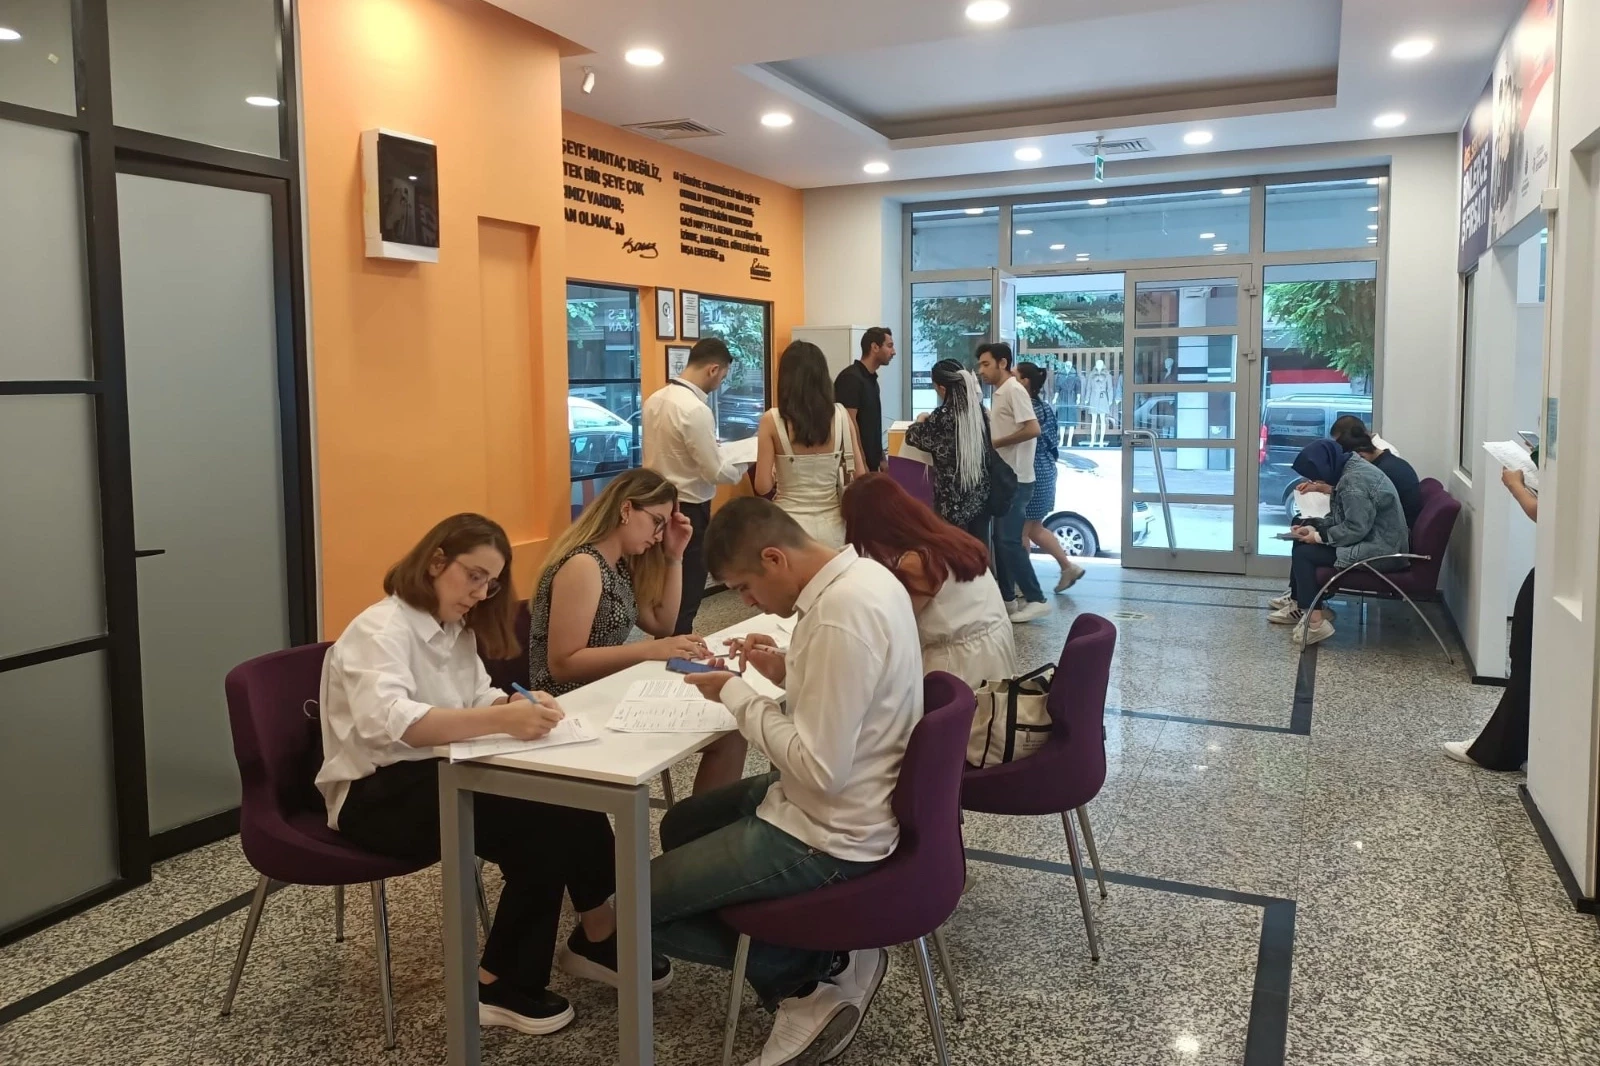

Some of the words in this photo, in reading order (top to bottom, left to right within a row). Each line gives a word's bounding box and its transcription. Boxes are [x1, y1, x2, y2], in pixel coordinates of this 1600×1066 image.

[563, 161, 583, 179] TEK
[584, 166, 600, 184] BİR
[602, 175, 625, 191] ŞEYE
[627, 180, 644, 196] ÇOK
[588, 146, 626, 172] MUHTAÇ
[628, 159, 662, 182] DEĞİLİZ,
[587, 190, 624, 213] VARDIR;
